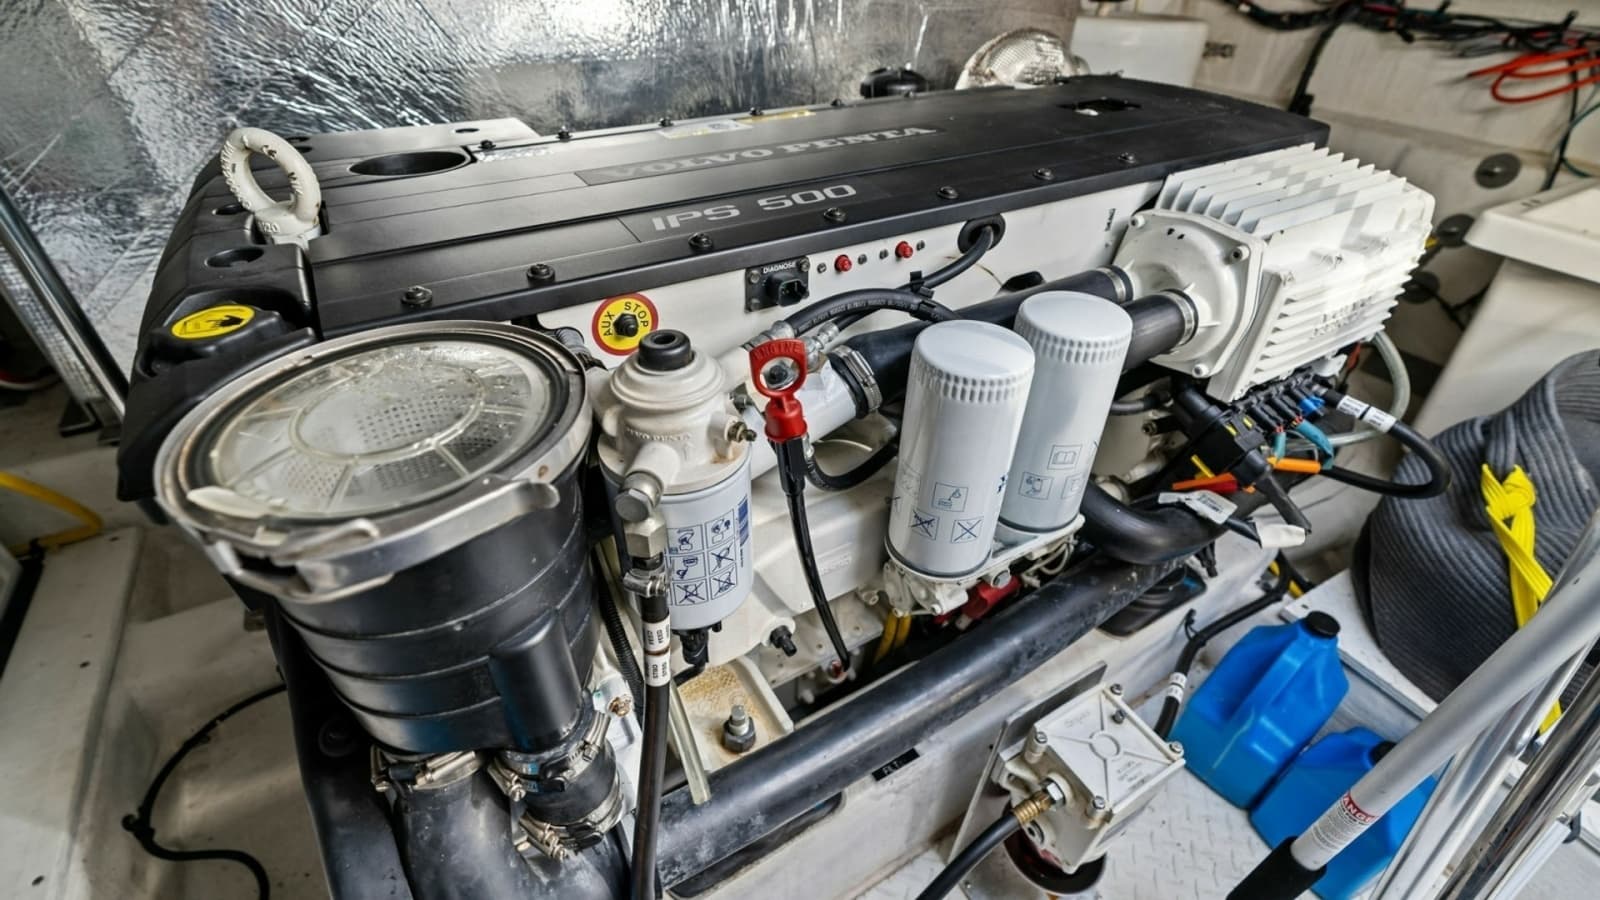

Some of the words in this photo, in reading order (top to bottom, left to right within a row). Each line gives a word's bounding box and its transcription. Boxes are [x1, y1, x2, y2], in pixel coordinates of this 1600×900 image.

[602, 148, 774, 178] VOLVO
[781, 126, 937, 153] PENTA
[651, 204, 741, 231] IPS
[757, 184, 857, 211] 500
[762, 261, 797, 274] DIAGNOSE
[601, 310, 615, 337] AUX
[624, 301, 649, 328] STOP
